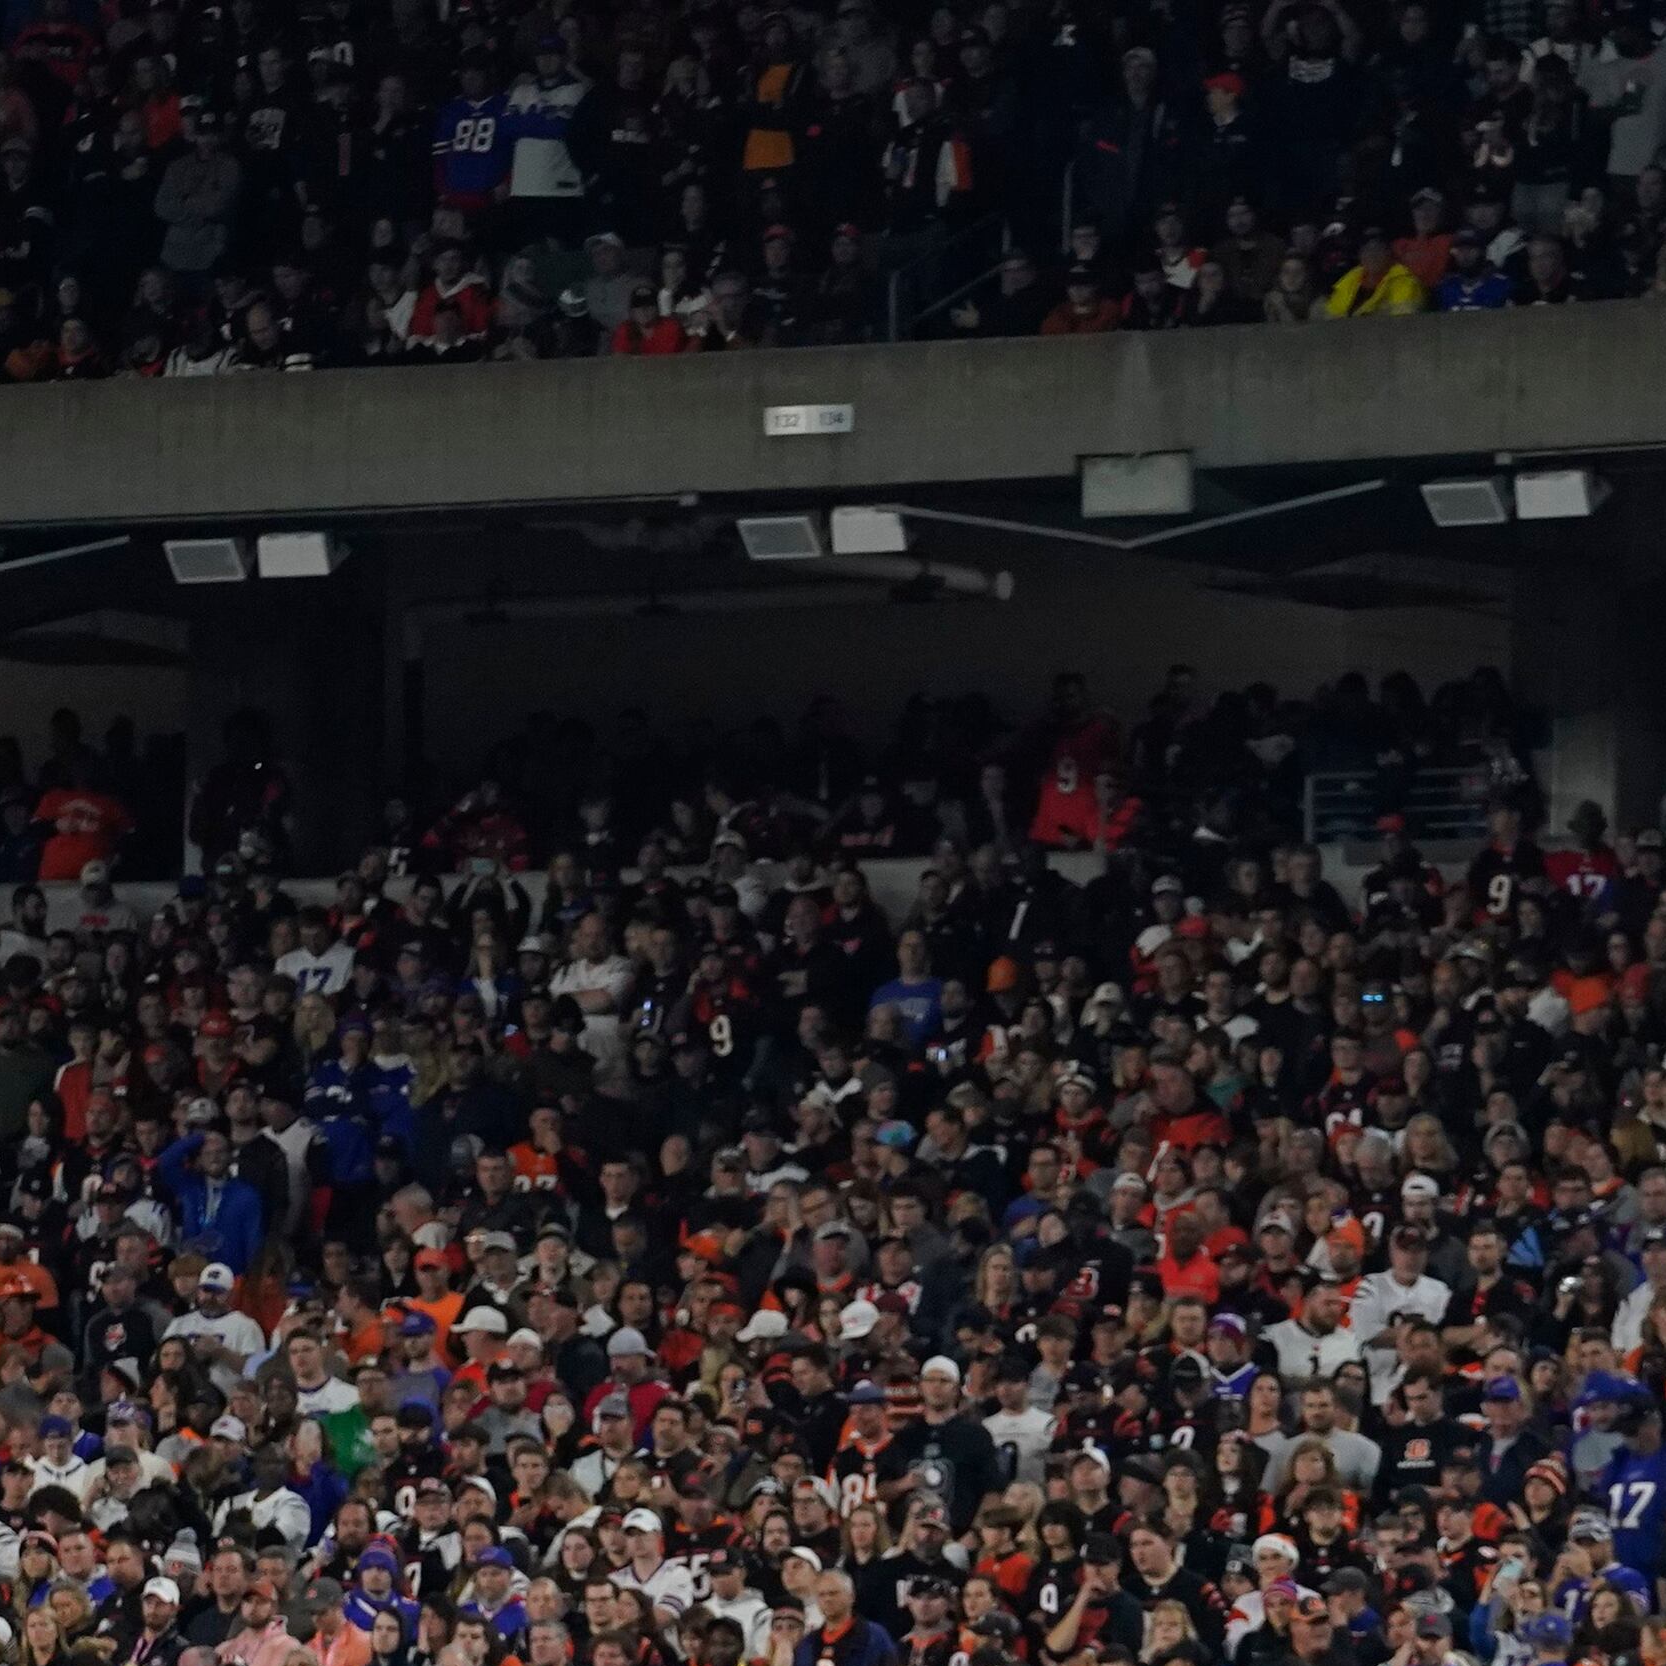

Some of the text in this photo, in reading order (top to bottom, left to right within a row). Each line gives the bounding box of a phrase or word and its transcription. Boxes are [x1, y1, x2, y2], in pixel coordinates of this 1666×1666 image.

[453, 119, 494, 153] 88
[1490, 876, 1511, 913] 9
[710, 1014, 733, 1055] 9
[1608, 1482, 1658, 1529] 17
